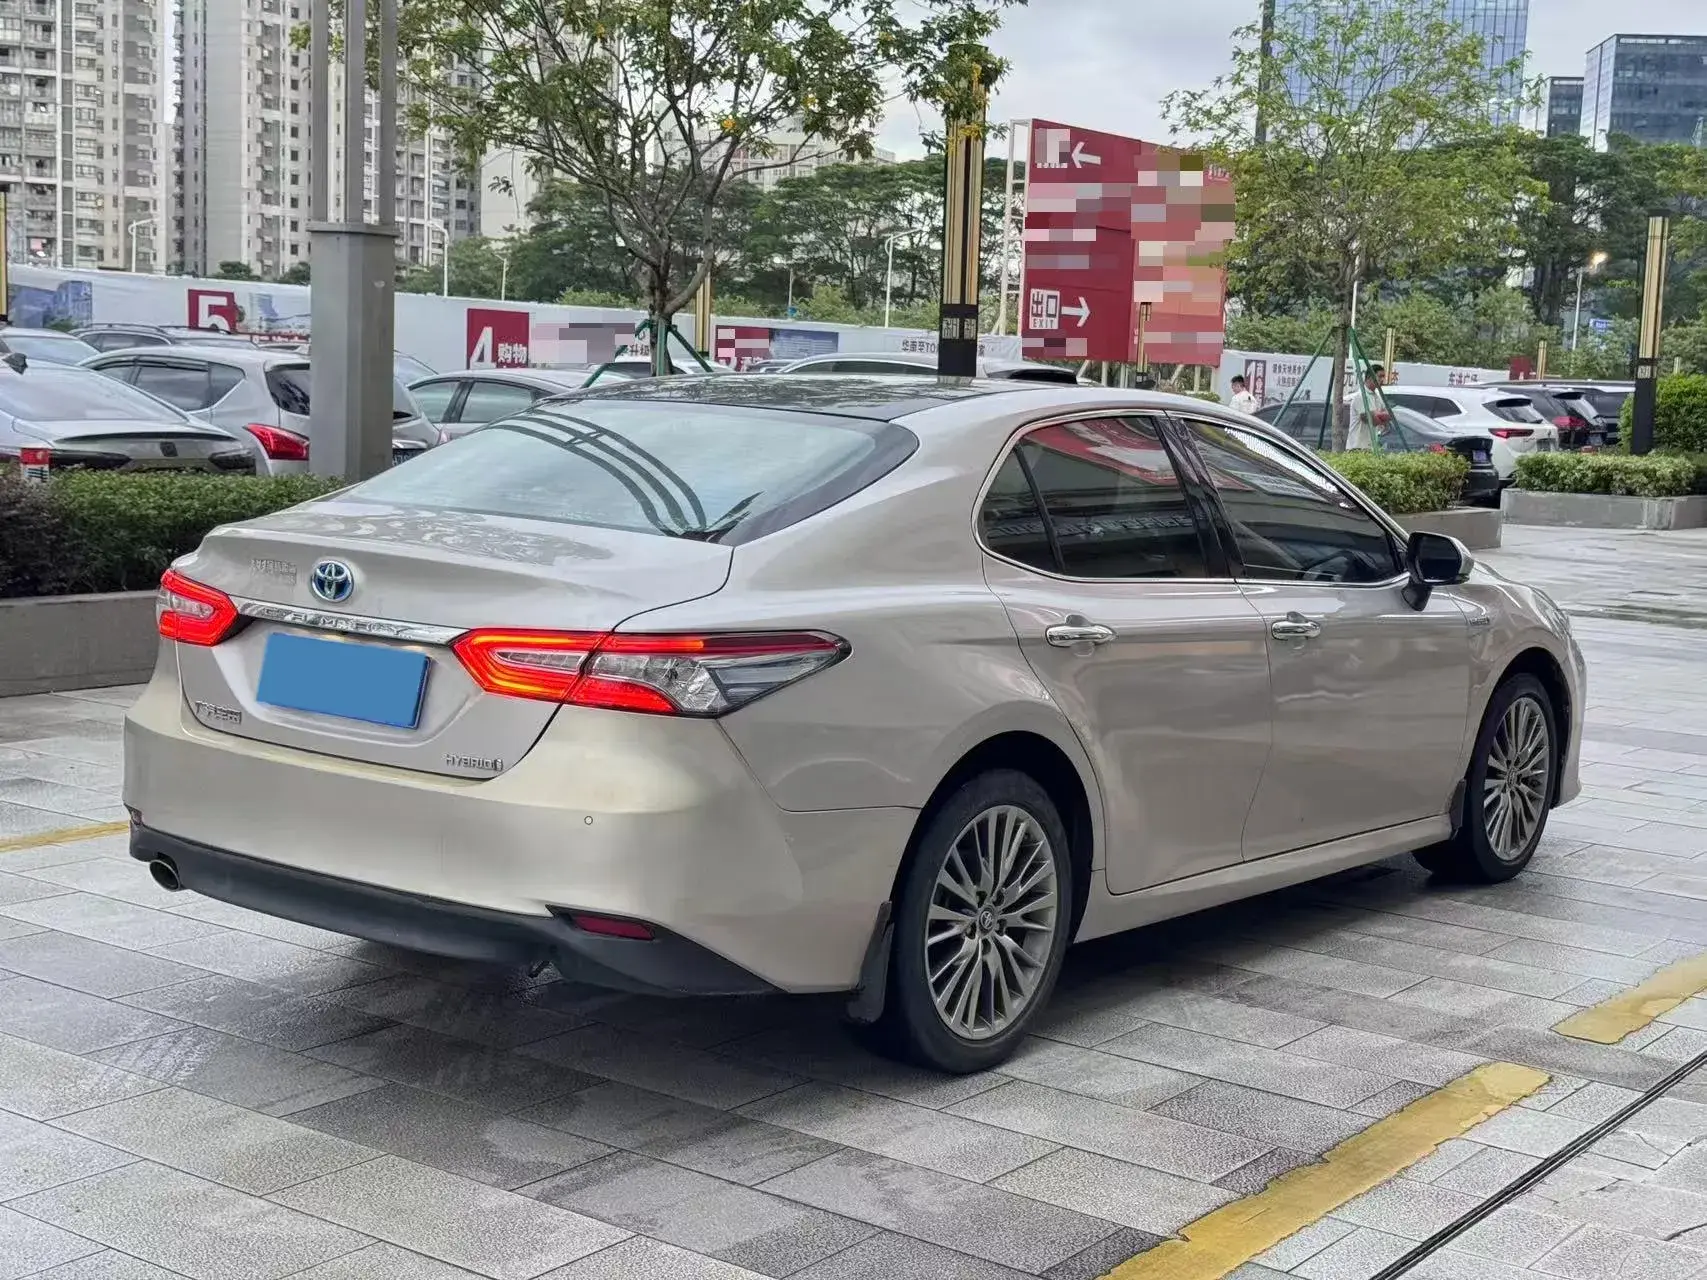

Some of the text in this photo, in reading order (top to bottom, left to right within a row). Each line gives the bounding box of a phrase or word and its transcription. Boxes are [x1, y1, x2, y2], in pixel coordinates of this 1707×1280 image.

[198, 295, 231, 334] 5
[1032, 291, 1058, 318] 出口
[1033, 319, 1054, 329] EXIT
[469, 326, 496, 369] 4
[497, 343, 528, 364] 购物
[446, 753, 494, 769] HYBRID
